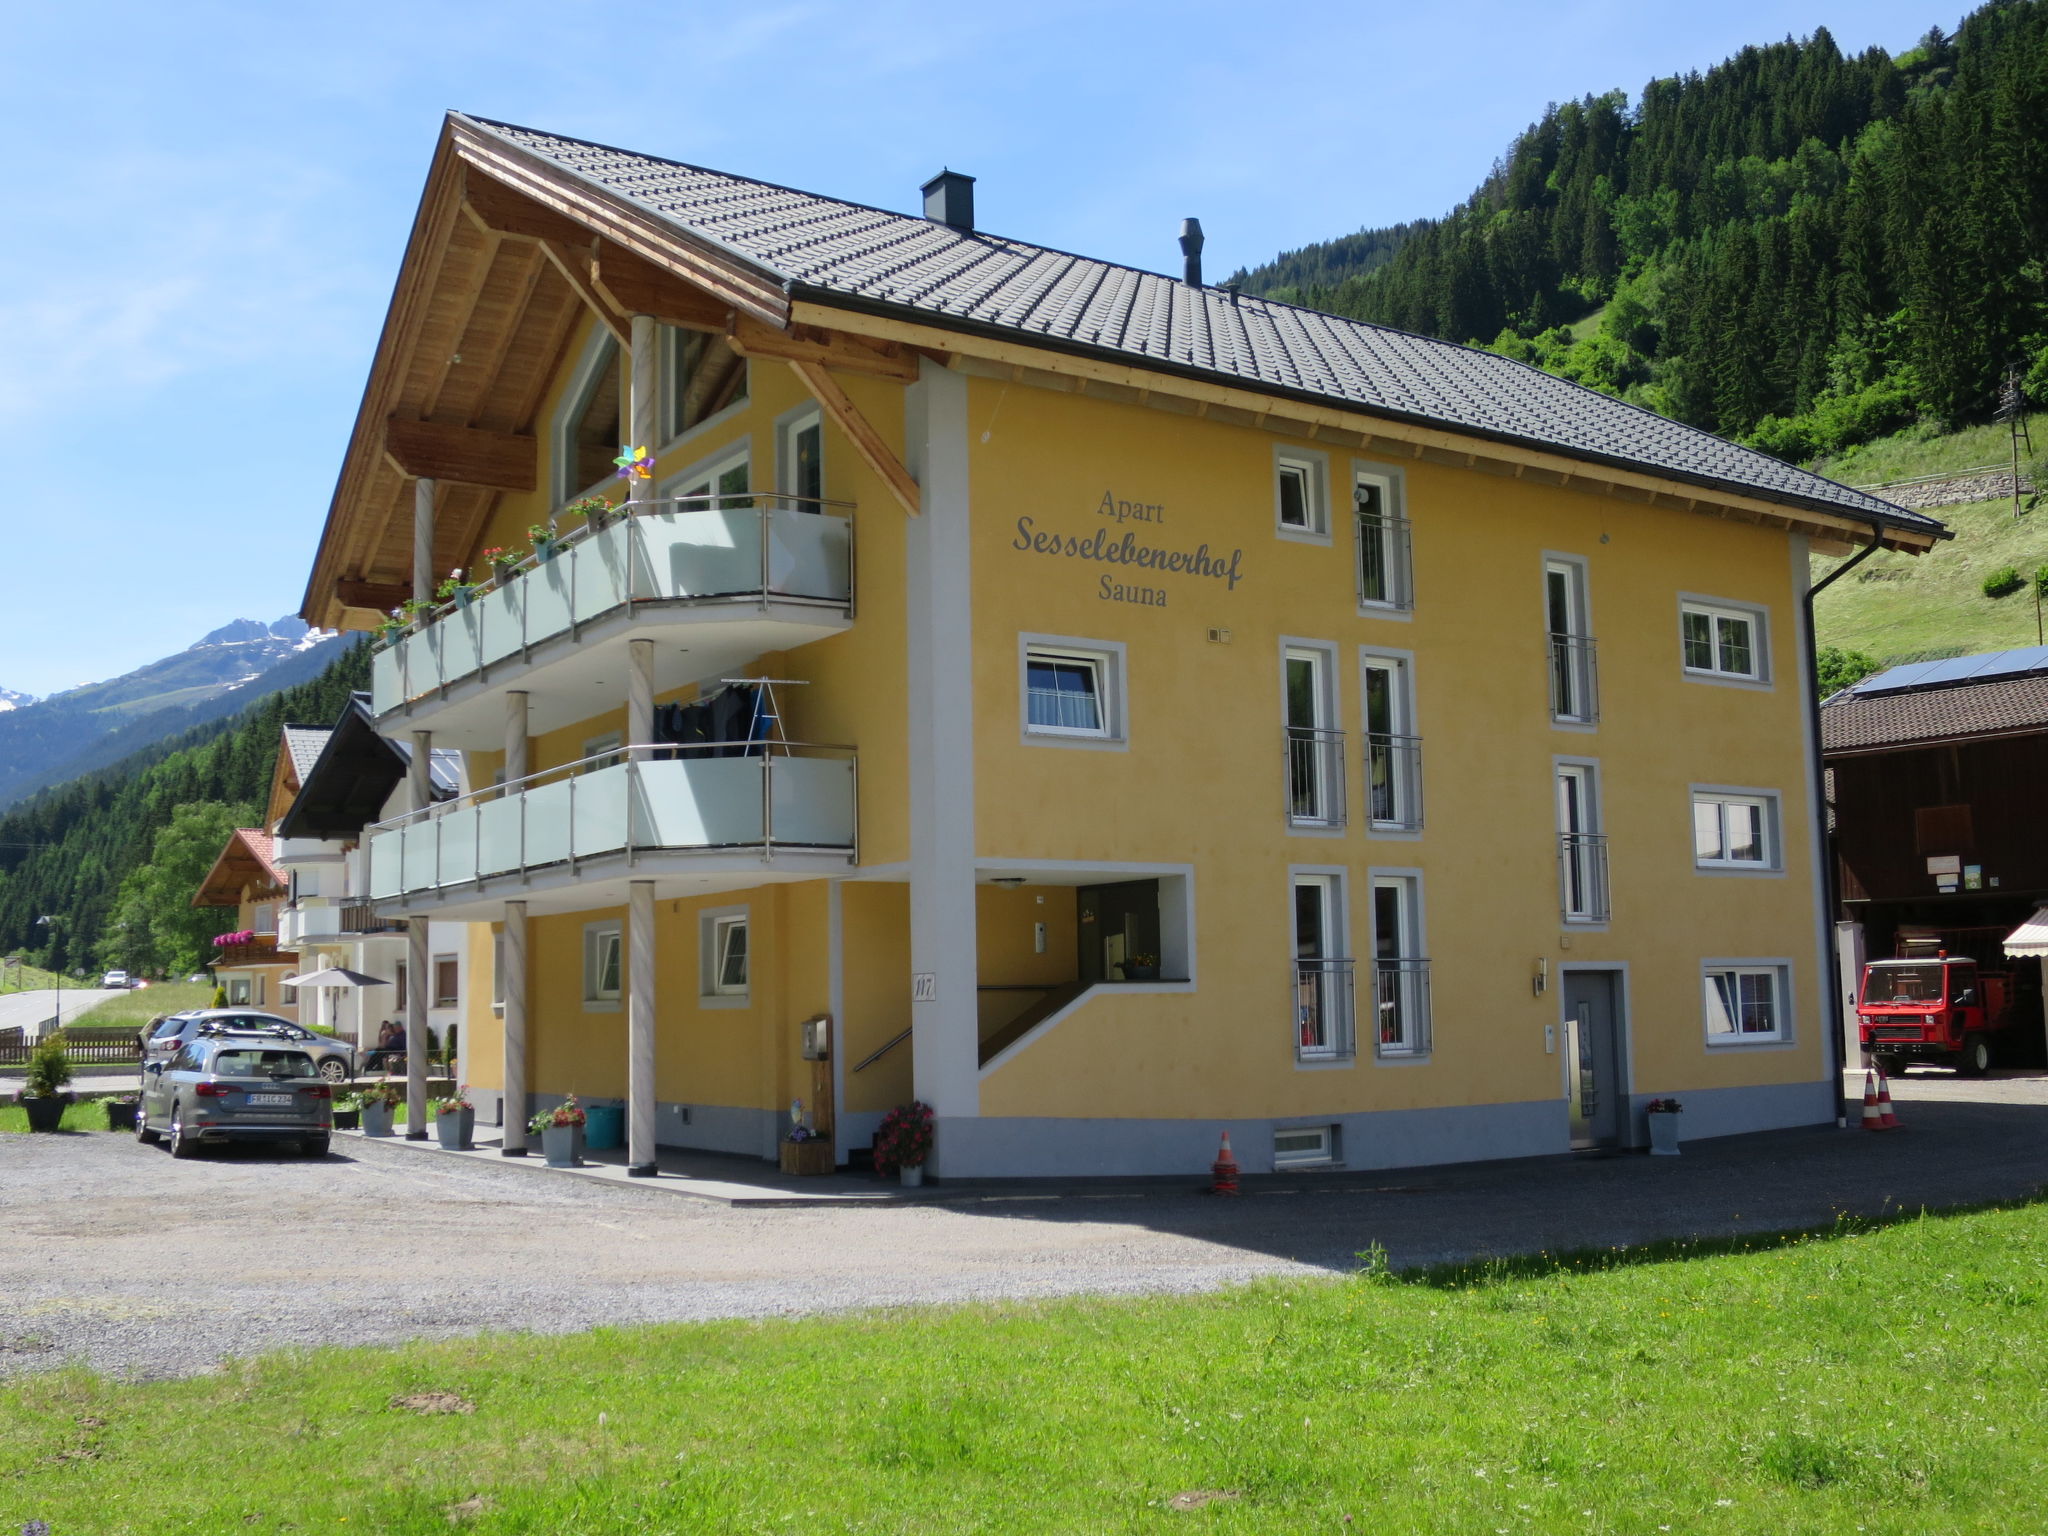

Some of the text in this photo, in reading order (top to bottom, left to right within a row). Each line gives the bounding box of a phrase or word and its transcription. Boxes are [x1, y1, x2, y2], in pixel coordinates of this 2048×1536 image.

[1097, 490, 1164, 523] Apart
[1012, 516, 1243, 591] Sesselebenerhof
[1098, 574, 1168, 607] Sauna
[916, 979, 932, 996] 117
